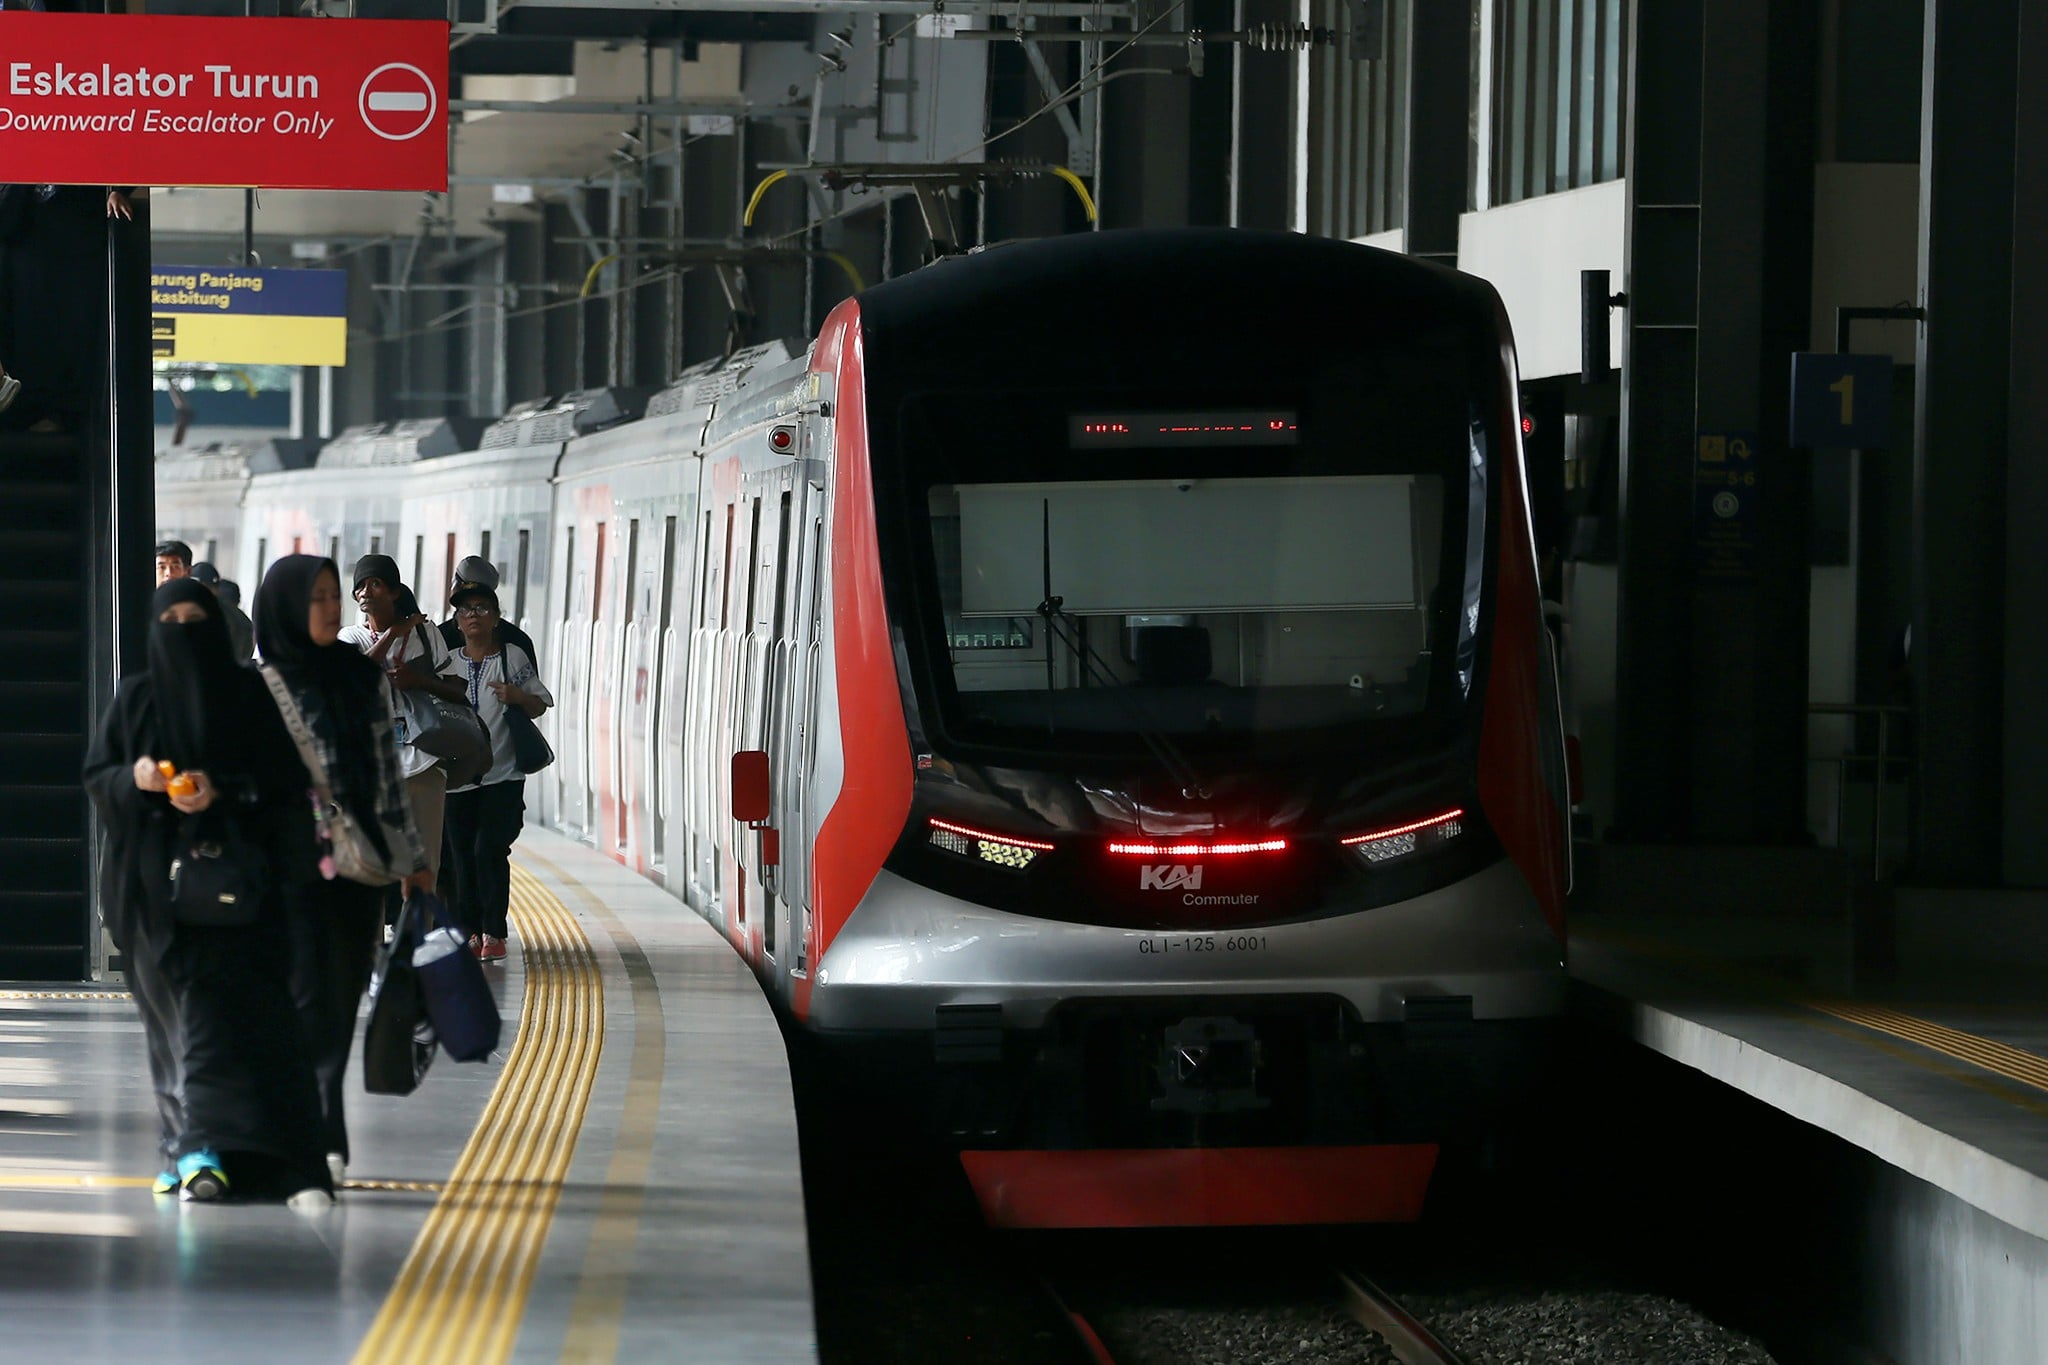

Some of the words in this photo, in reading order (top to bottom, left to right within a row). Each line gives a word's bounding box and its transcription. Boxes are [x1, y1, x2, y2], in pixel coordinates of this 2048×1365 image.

[9, 62, 194, 98] Eskalator
[204, 65, 319, 99] Turun
[0, 107, 136, 133] Downward
[143, 109, 267, 135] Escalator
[273, 111, 335, 140] Only
[200, 272, 263, 292] Panjang
[1829, 374, 1855, 425] 1
[1140, 865, 1203, 890] KAI
[1183, 893, 1259, 906] Commuter
